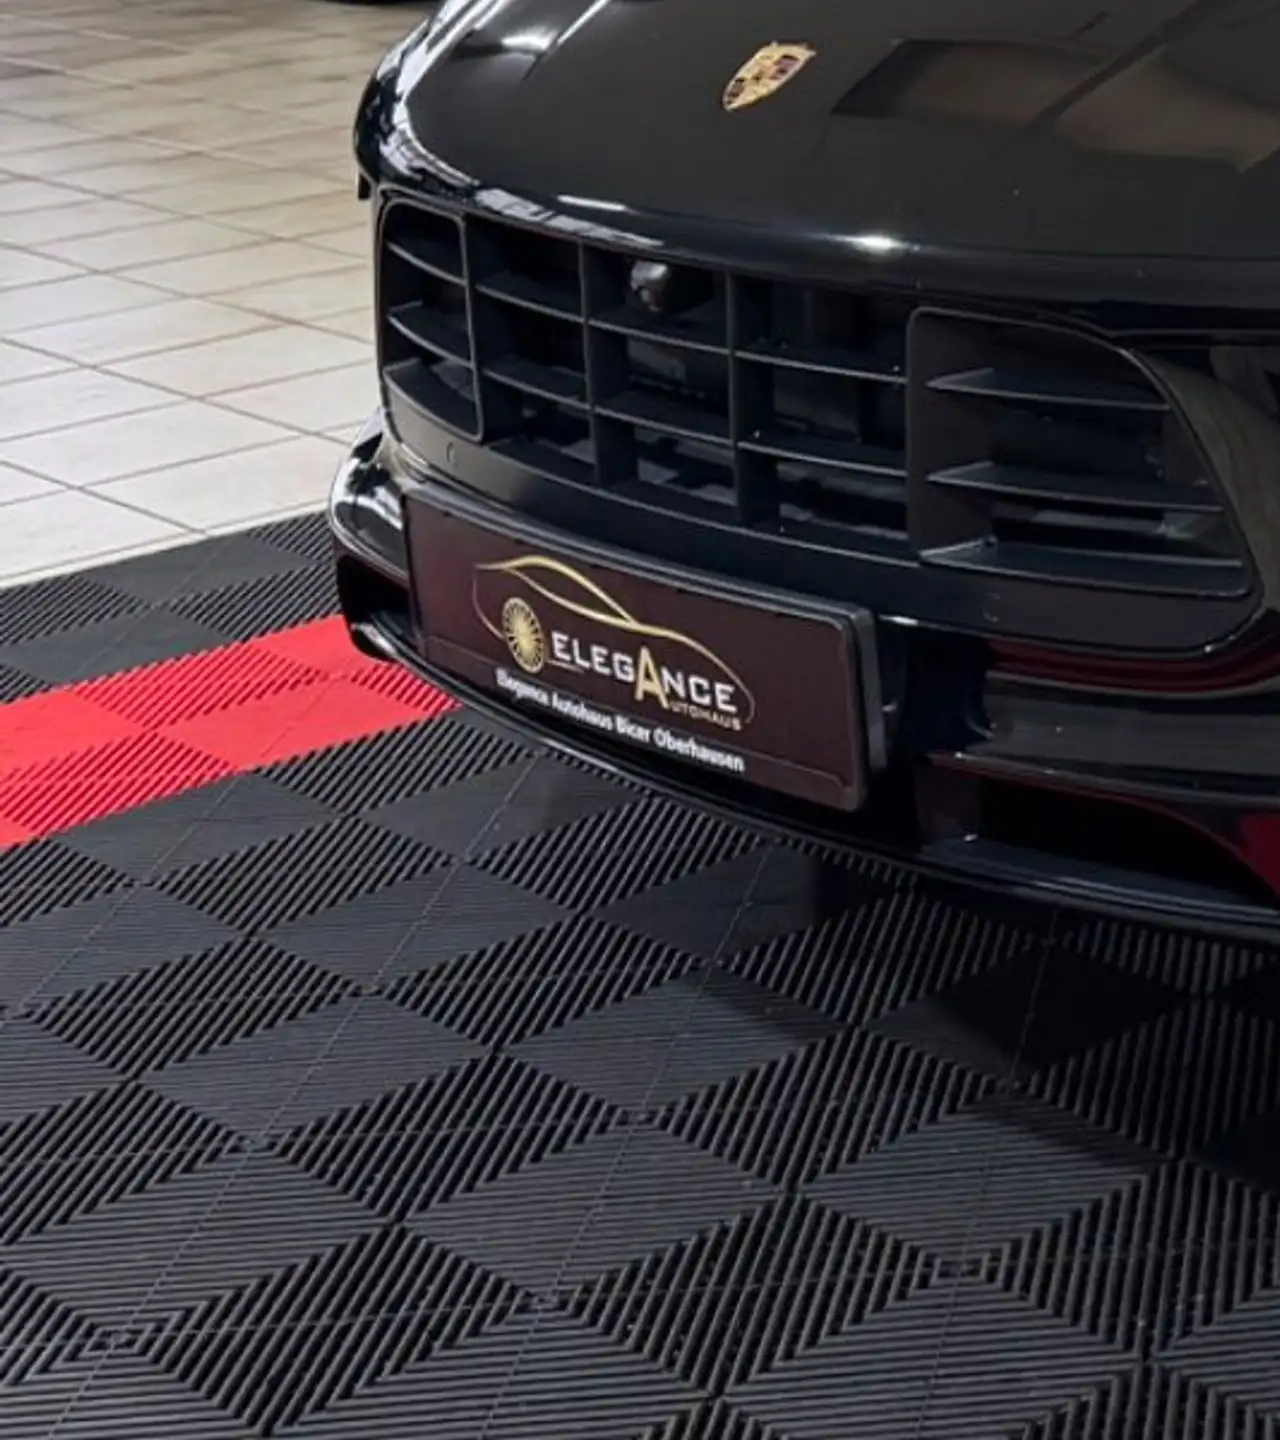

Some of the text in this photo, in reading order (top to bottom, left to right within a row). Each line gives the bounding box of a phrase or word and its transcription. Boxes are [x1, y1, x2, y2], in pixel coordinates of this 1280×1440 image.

[551, 630, 738, 714] ELEGANCE
[551, 691, 614, 731] Autohaus
[652, 726, 746, 773] Oberhausen
